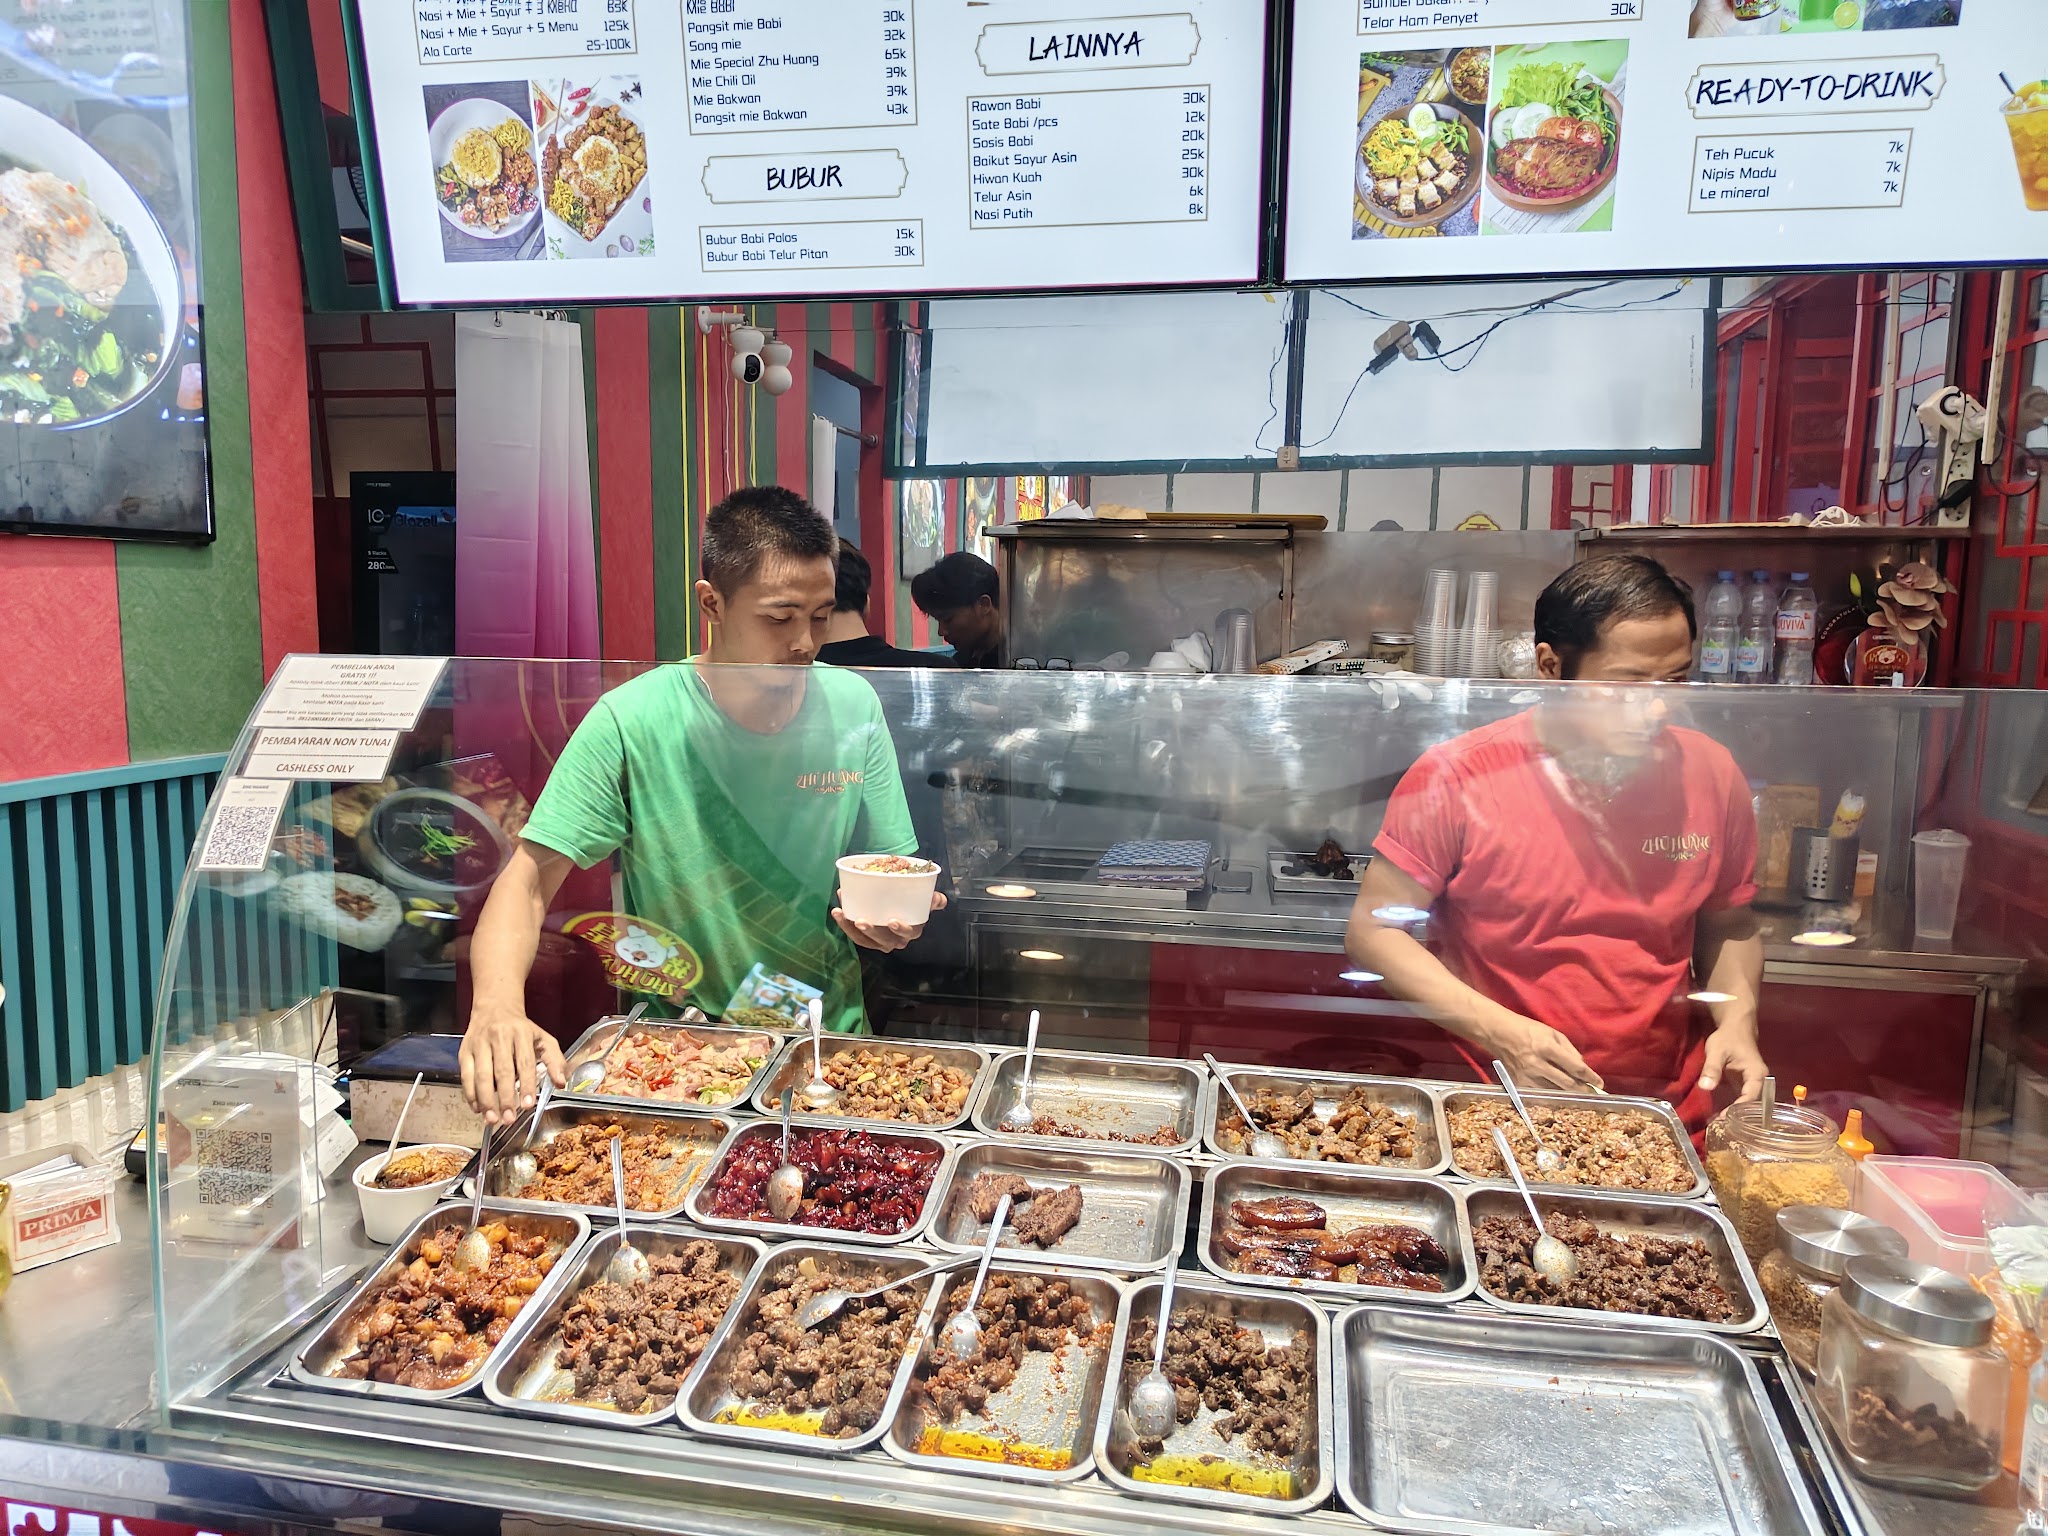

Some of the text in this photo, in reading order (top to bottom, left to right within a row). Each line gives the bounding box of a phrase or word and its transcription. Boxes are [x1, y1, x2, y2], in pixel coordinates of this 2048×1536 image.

[420, 11, 442, 21] Nasi
[457, 9, 476, 19] Mie
[491, 7, 521, 21] Sayur
[688, 10, 905, 34] Pangsit mie Babi 30k
[1399, 16, 1428, 27] Ham
[1434, 12, 1478, 26] Penyet
[1611, 3, 1636, 15] 30k
[421, 29, 443, 39] Nasi
[458, 27, 477, 37] Mie
[492, 25, 522, 37] Sayur
[549, 21, 578, 32] Menu
[604, 20, 629, 31] 125k
[424, 39, 631, 57] Ala Carte 25-100k
[722, 39, 741, 49] mie
[885, 30, 905, 40] 32k
[1029, 31, 1144, 61] LAINNYA
[691, 49, 906, 70] Mie Special Zhu Huang 65k
[692, 67, 907, 87] Mie Chili Oil 39k
[694, 86, 907, 105] Mie Bakwan 39k
[1696, 71, 1933, 105] READY-TO-DRINK
[1016, 98, 1041, 110] Babi
[1183, 92, 1205, 104] 30k
[695, 104, 908, 125] Pangsit mie Bakwan 43k
[972, 112, 1205, 130] Sate Babi /pcs 12k
[973, 130, 1204, 149] Sosis Babi 20k
[973, 149, 1204, 167] Baikut Sayur Asin 25k
[1705, 142, 1904, 160] Teh Pucuk 7k
[767, 165, 842, 190] BUBUR
[973, 167, 1204, 184] Hiwan Kuah 30k
[1702, 162, 1900, 182] Nipis Madu 7k
[974, 186, 1204, 202] Telur Asin 6k
[1700, 181, 1897, 199] Le mineral 7k
[974, 203, 1203, 220] Nasi Putih 8k
[706, 235, 737, 245] Bubur
[741, 233, 764, 244] Babi
[896, 229, 914, 239] 15k
[708, 246, 915, 262] Bubur Babi Telur Pitan 30k
[261, 736, 392, 747] PEMBAYARAN NON TUNAI
[276, 763, 355, 774] CASHLESS ONLY
[24, 1205, 98, 1238] PRIMA
